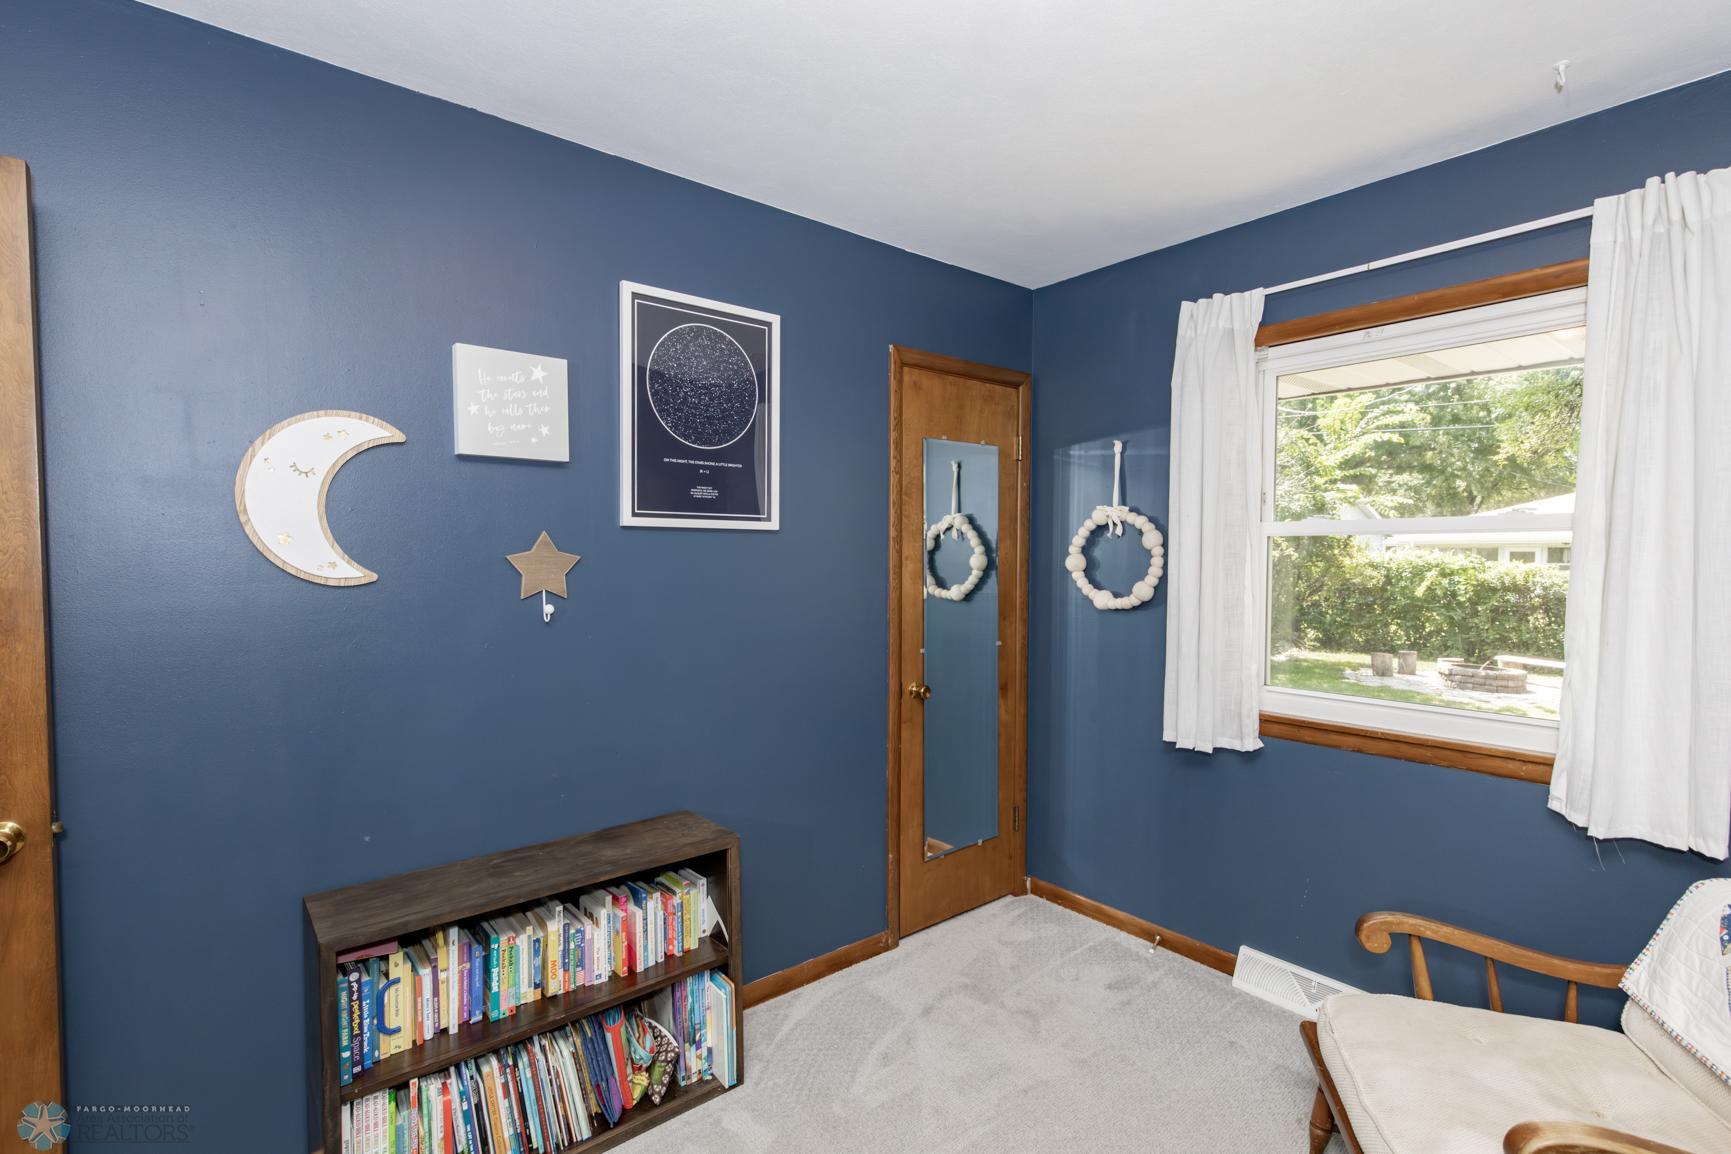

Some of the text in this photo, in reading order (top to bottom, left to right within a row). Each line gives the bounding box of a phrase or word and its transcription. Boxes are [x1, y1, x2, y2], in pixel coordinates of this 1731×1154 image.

[503, 388, 526, 401] stars
[532, 386, 549, 399] and
[352, 1036, 361, 1061] Space
